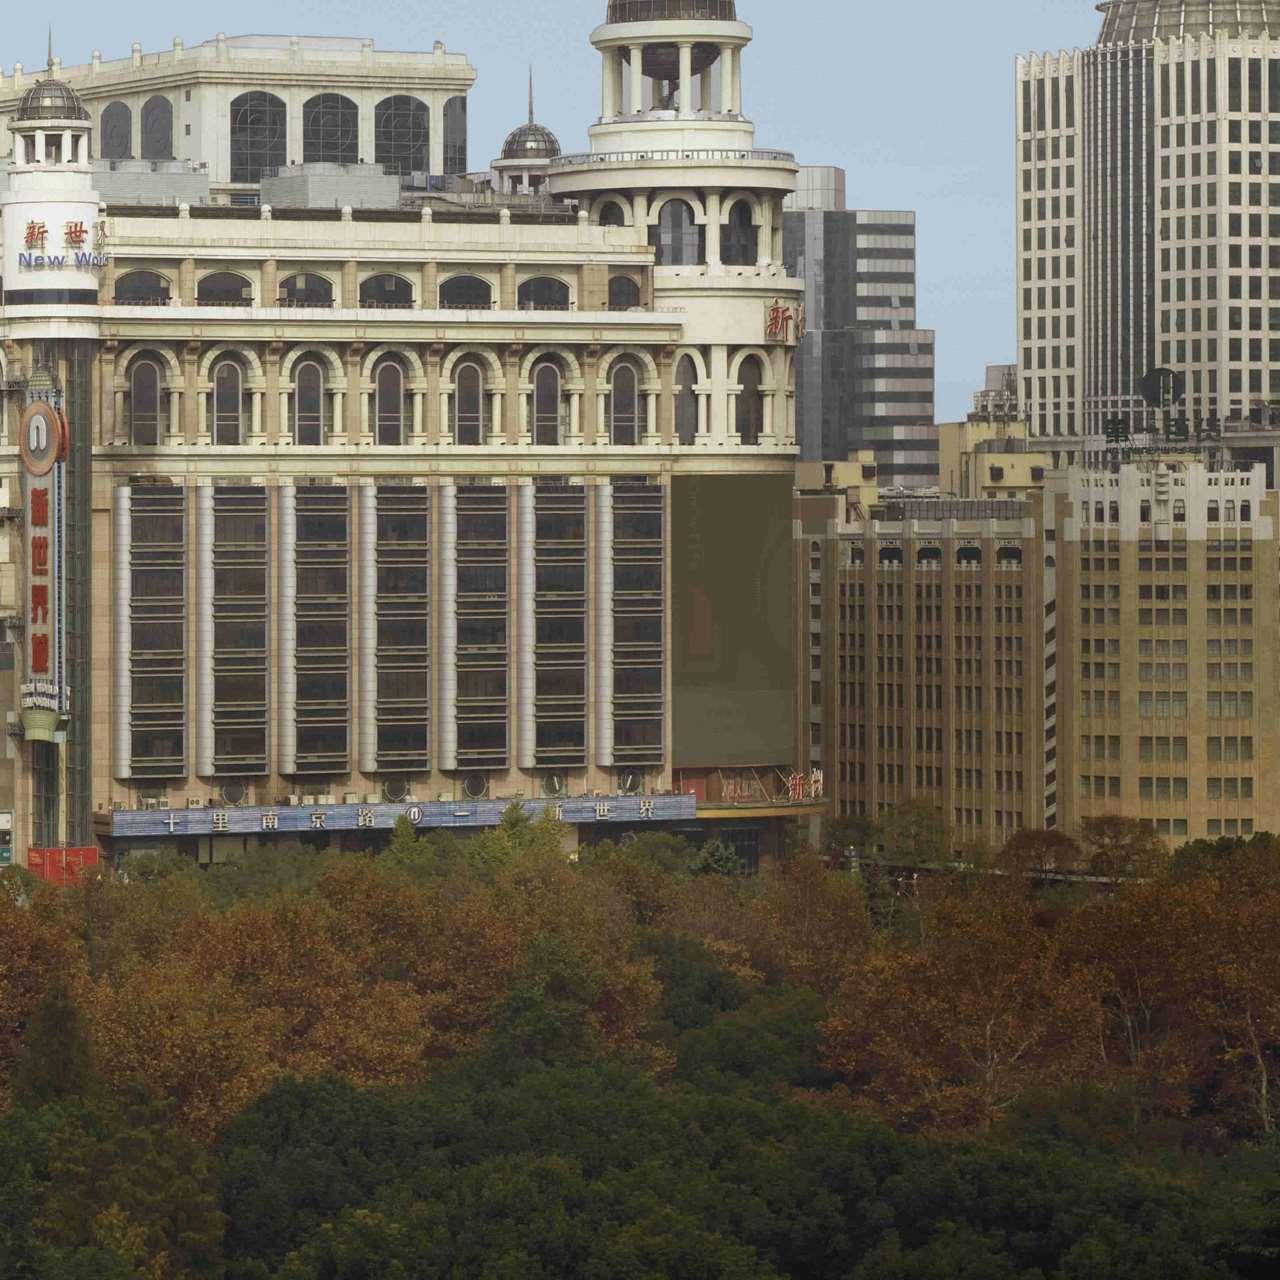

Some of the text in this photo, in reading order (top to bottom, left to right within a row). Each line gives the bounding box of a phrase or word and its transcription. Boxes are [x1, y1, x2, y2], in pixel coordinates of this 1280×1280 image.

[18, 252, 65, 267] New
[163, 806, 376, 833] 十里南京路
